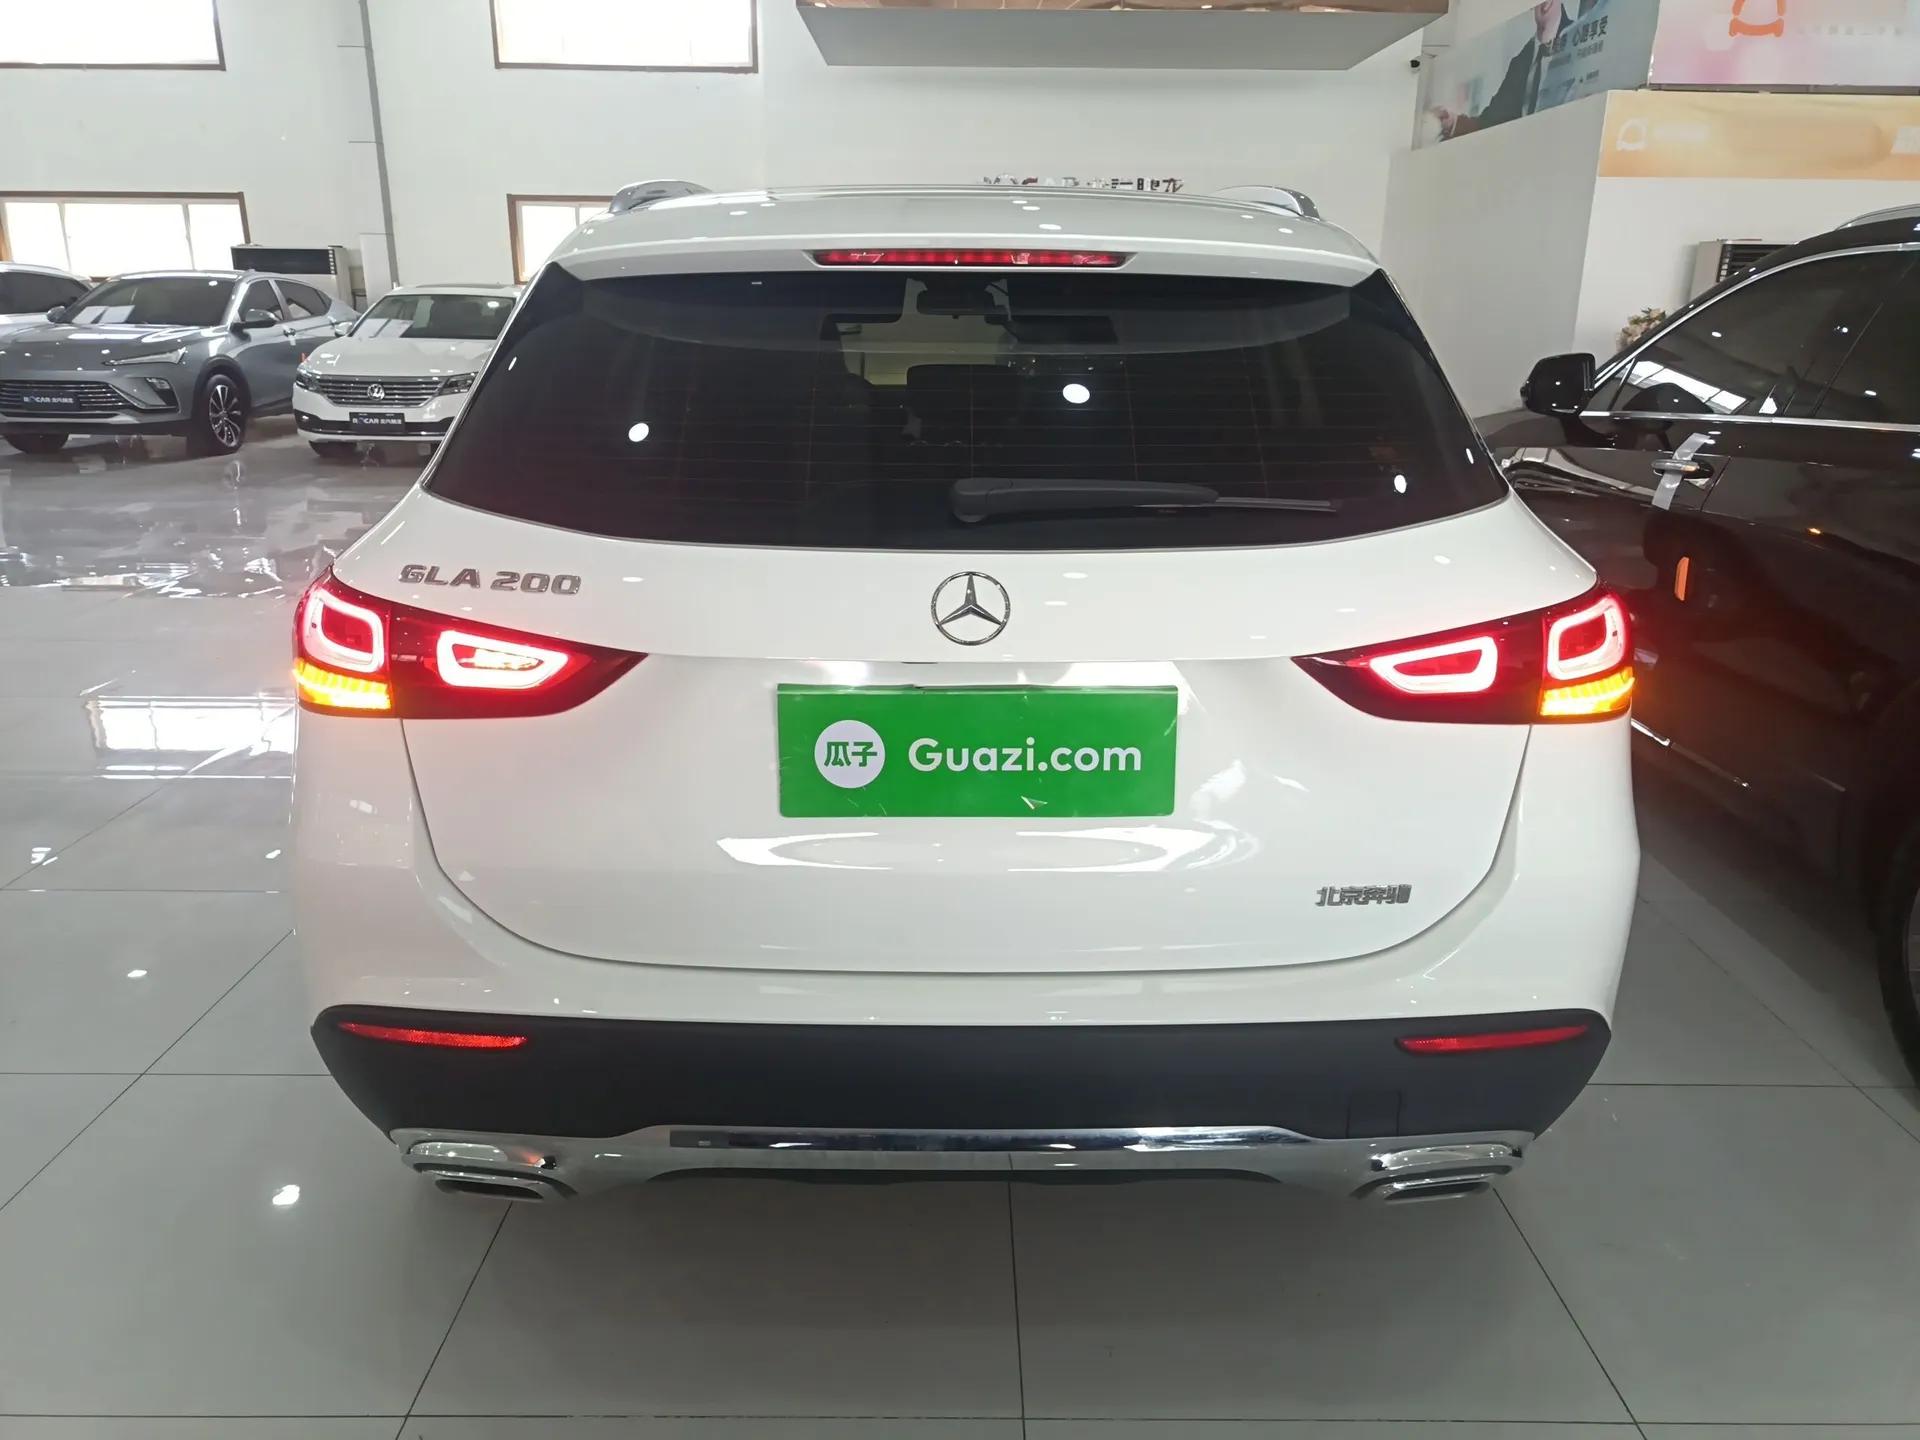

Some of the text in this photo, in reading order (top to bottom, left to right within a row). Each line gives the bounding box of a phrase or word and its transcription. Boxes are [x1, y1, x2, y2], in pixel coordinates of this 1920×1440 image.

[398, 564, 581, 595] GLA 200
[824, 741, 878, 767] 瓜子
[909, 737, 1142, 772] Guazi.com
